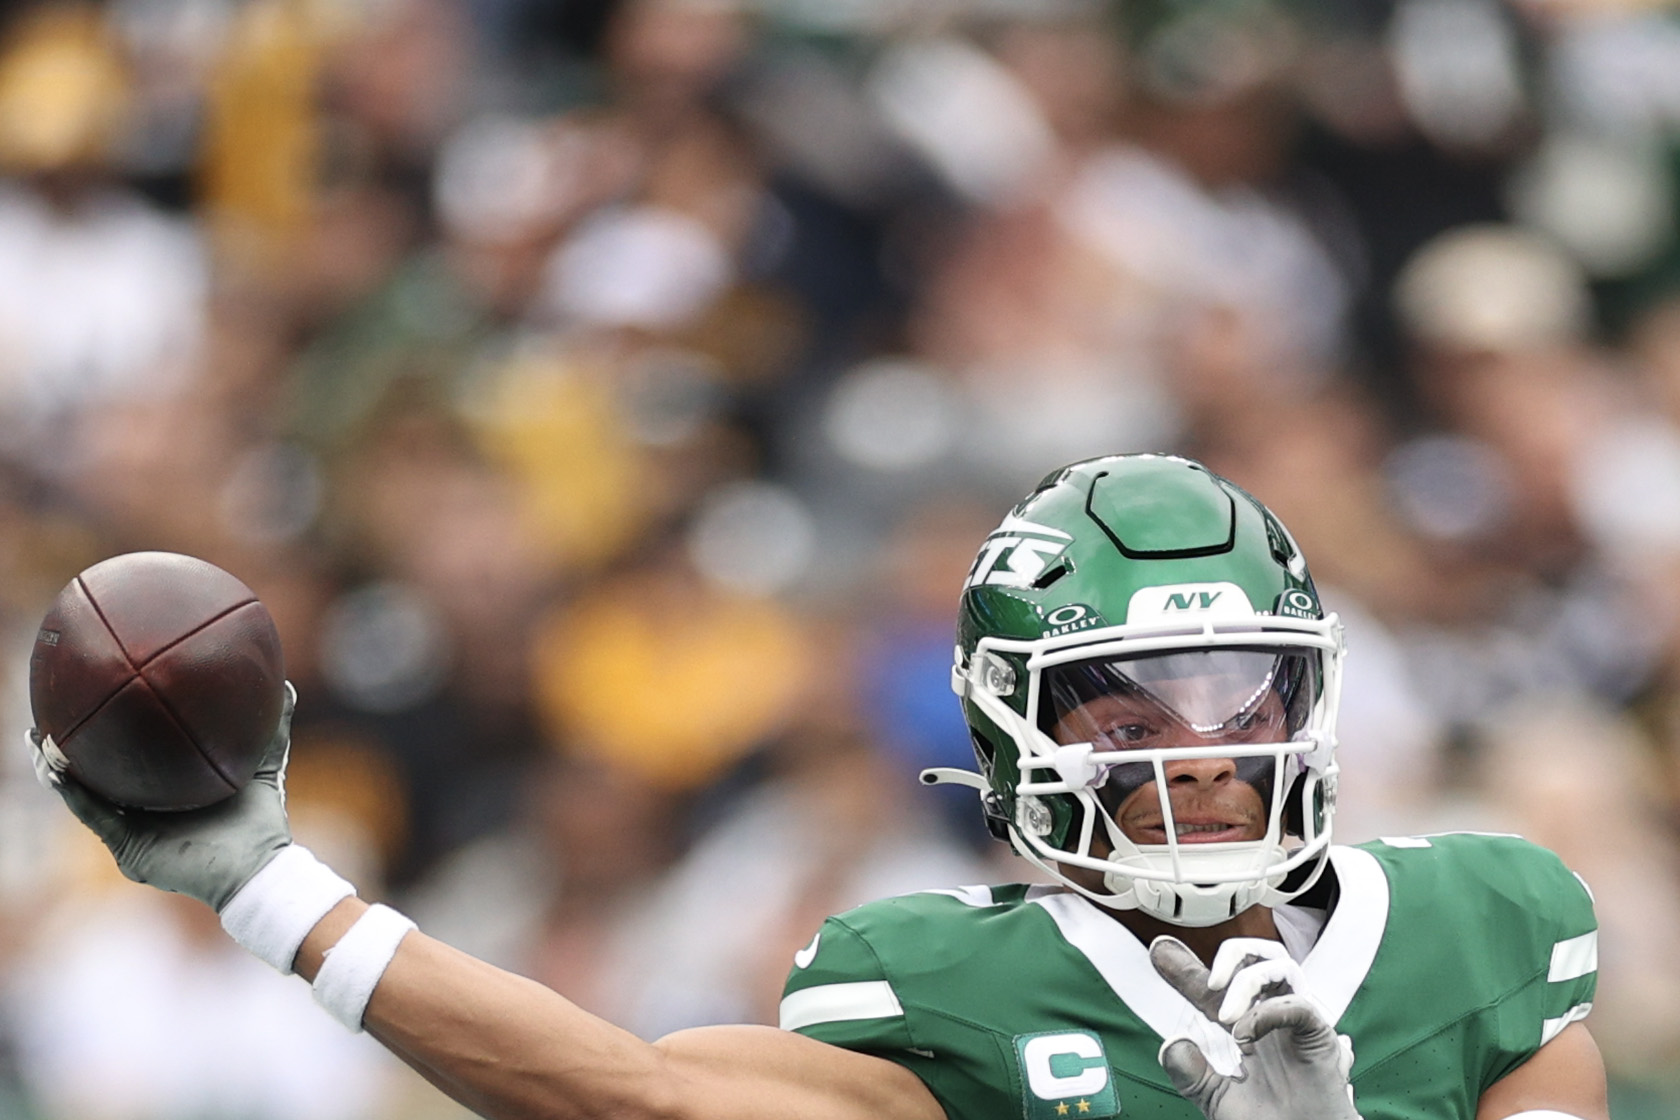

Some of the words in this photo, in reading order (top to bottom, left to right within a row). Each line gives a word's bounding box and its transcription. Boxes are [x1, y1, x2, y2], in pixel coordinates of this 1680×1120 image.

[1163, 591, 1223, 611] NY
[1043, 616, 1097, 639] OAKLEY
[1024, 1033, 1109, 1101] C
